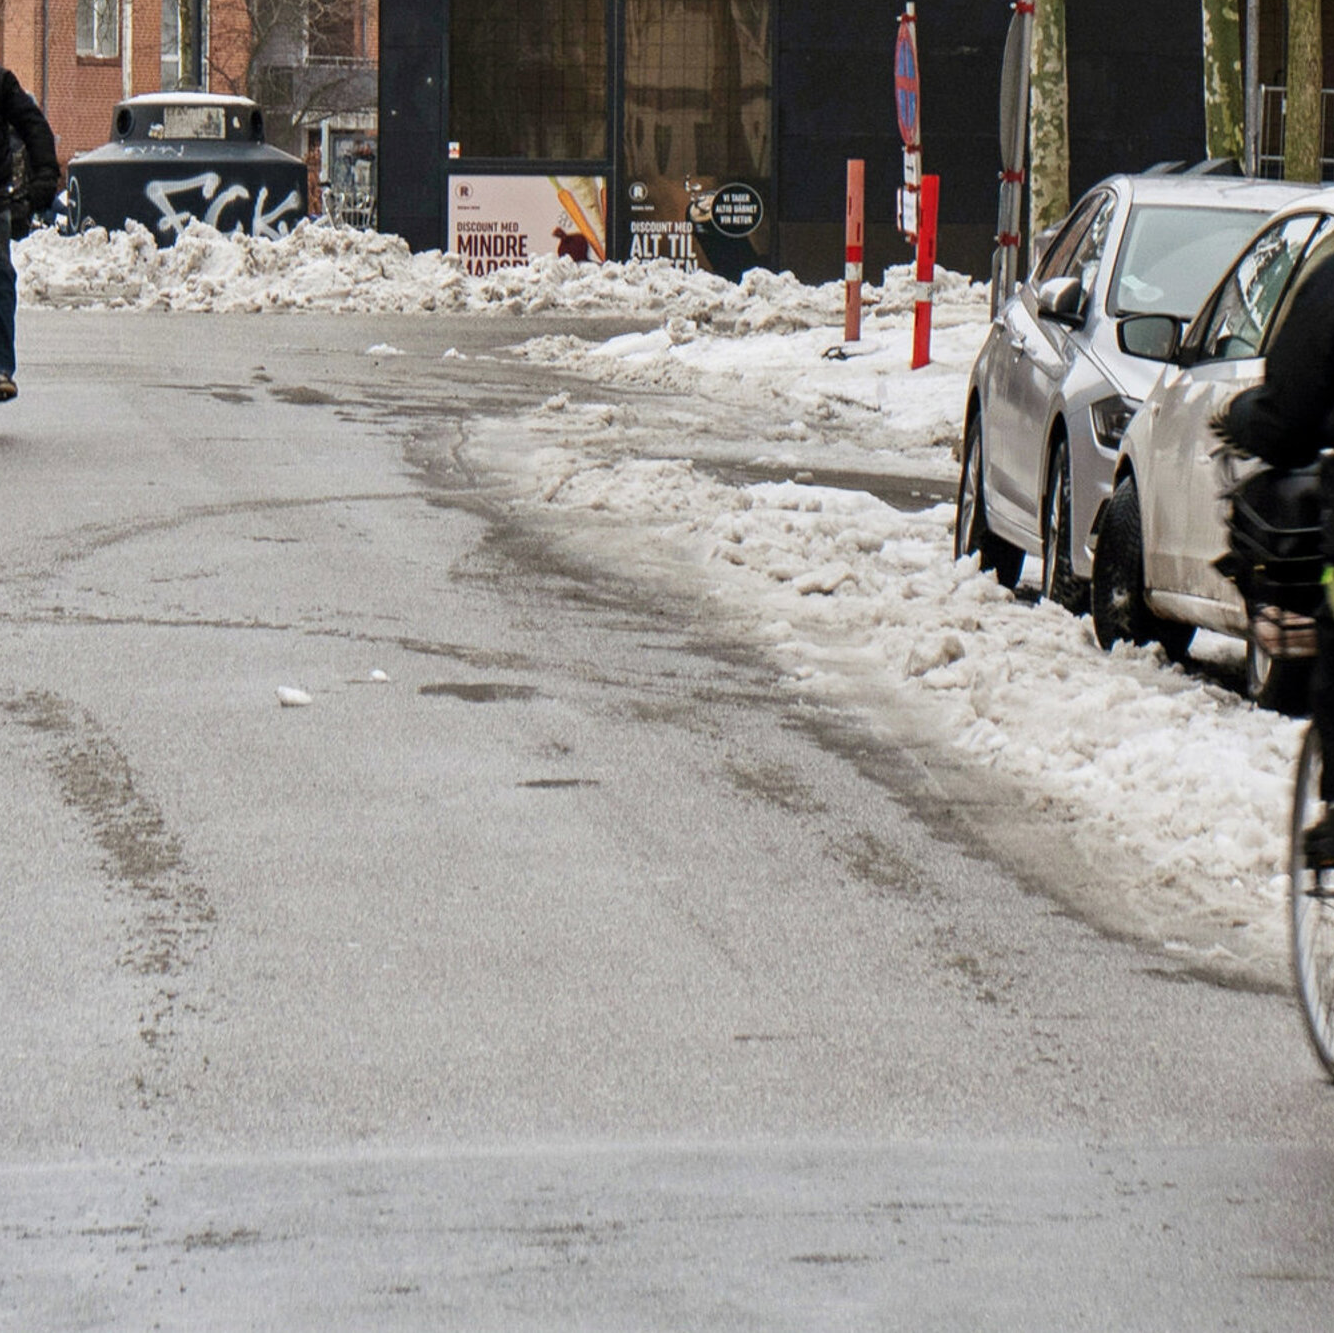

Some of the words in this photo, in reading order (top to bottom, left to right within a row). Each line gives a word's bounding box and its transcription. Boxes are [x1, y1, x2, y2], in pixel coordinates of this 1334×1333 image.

[457, 222, 498, 233] DISCOUNT
[501, 222, 519, 233] MED
[631, 221, 672, 233] DISCOUNT
[675, 221, 693, 233] MED
[457, 234, 528, 257] MINDRE
[630, 234, 662, 258] ALT
[668, 234, 697, 258] TIL
